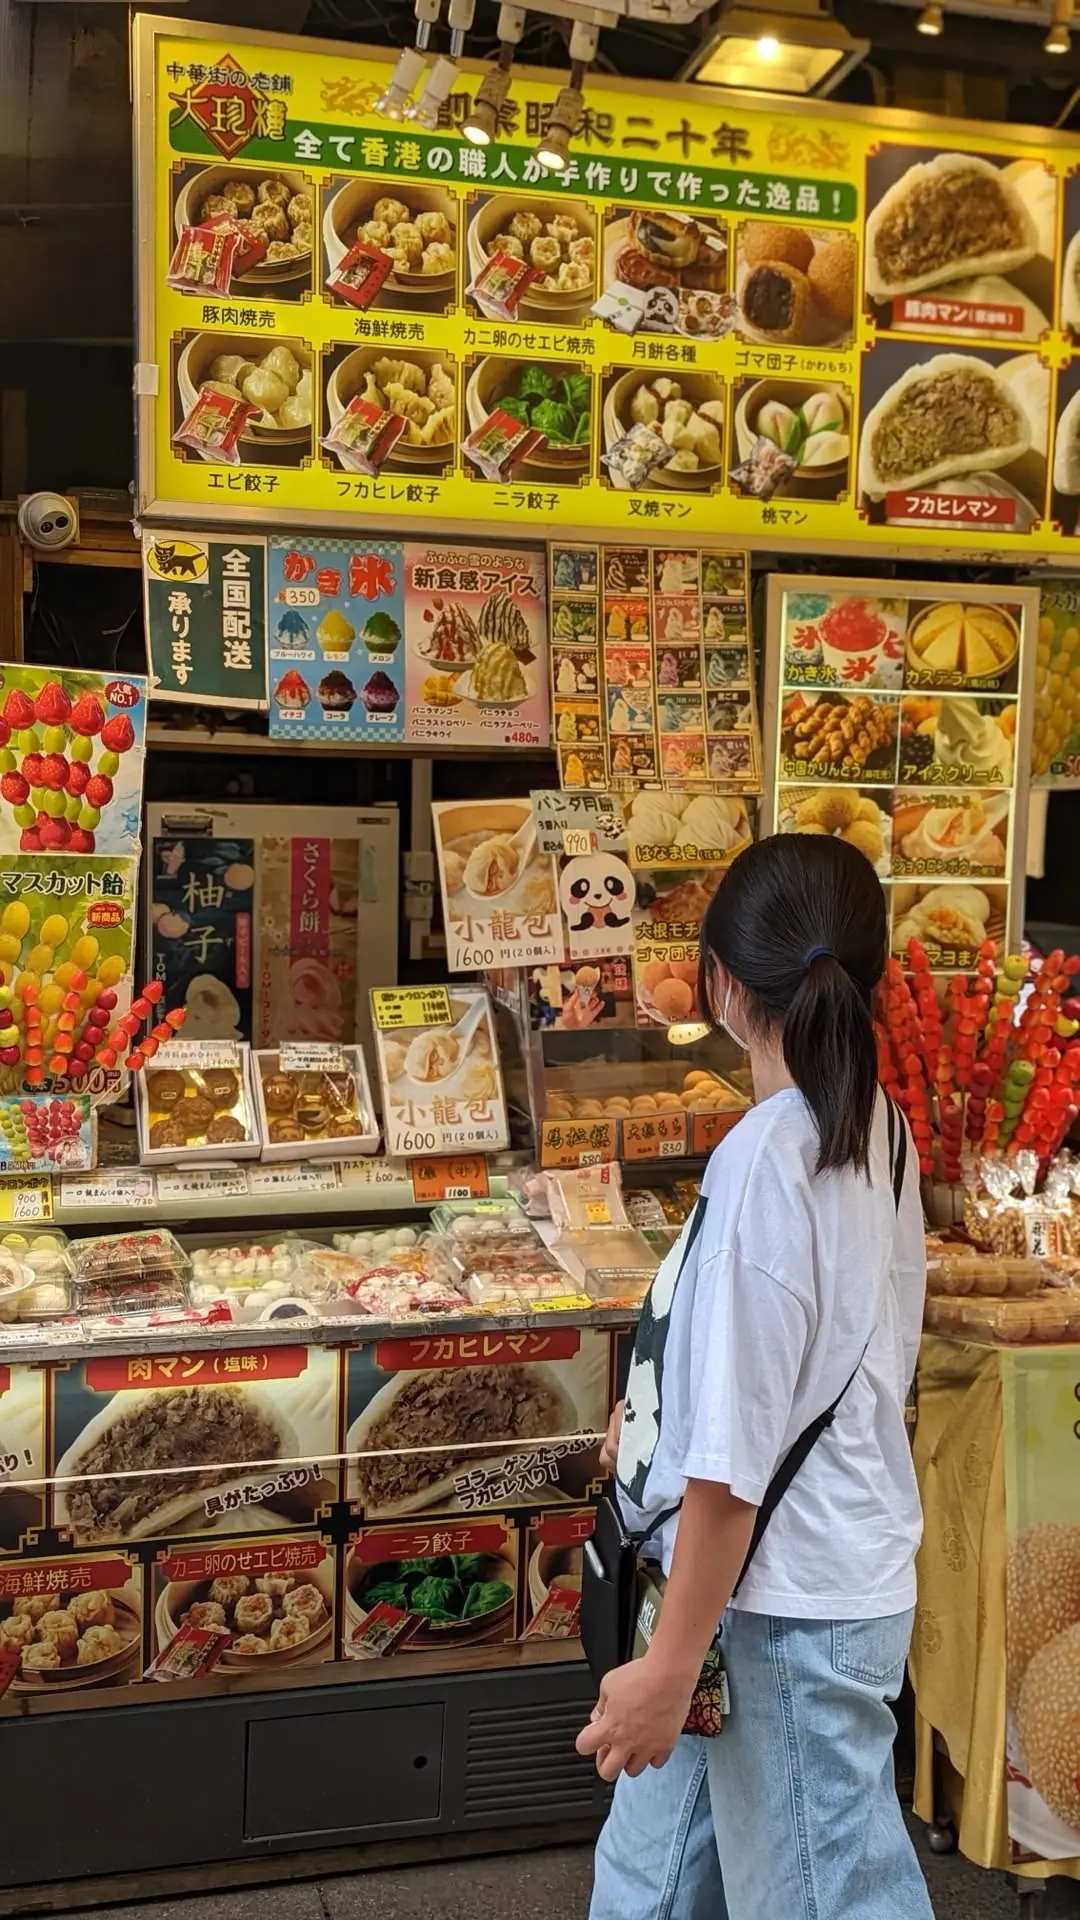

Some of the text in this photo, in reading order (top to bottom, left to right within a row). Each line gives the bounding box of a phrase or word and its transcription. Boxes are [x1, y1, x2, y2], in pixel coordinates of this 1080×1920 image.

[293, 127, 843, 214] 全て香港の職人が手作りで作った逸品！
[202, 305, 276, 329] 豚肉焼売
[354, 317, 425, 342] 海鮮焼売
[463, 328, 595, 355] カニ卵のせエビ焼売
[632, 340, 697, 364] 月餅各種
[207, 473, 281, 493] エビ餃子
[336, 480, 441, 503] フカヒレ餃子
[493, 490, 560, 511] ニラ餃子
[628, 499, 692, 519] 叉焼マン
[904, 496, 998, 519] フカヒレマン
[761, 506, 809, 526] 桃マン
[282, 550, 398, 602] かき氷
[413, 567, 539, 596] 新食感アイス
[289, 590, 317, 604] 350
[221, 548, 253, 670] 全国配送
[167, 590, 194, 685] 承ります
[793, 625, 821, 651] 氷
[370, 654, 393, 663] メロン
[840, 654, 878, 682] 氷
[786, 665, 837, 681] かき氷
[109, 692, 133, 706] NO.1
[112, 682, 133, 695] 人気
[280, 710, 304, 719] イチゴ
[325, 712, 348, 721] コーラ
[367, 713, 395, 722] グレープ
[902, 762, 1004, 783] アイスクリーム
[2, 871, 124, 896] マスカット飴
[300, 841, 322, 934] さくら餅
[91, 911, 121, 923] 新商品
[181, 871, 225, 965] 柚子
[453, 908, 553, 943] 小龍包
[635, 921, 700, 941] 大根モチ
[455, 949, 495, 968] 1600
[636, 945, 701, 963] ゴマ団子
[895, 950, 983, 968] エマヨま
[395, 1095, 495, 1128] 小龍包
[395, 1131, 436, 1151] 1600
[662, 1141, 683, 1154] 830
[580, 1153, 602, 1166] 580
[375, 1171, 394, 1183] 600
[447, 1188, 469, 1197] 1100
[409, 1333, 551, 1362] フカヒレマン
[127, 1354, 270, 1382] 肉マン（塩味）
[453, 1428, 600, 1494] コラーゲンたっぷり
[205, 1463, 323, 1518] 具がたっぷり！
[459, 1462, 561, 1511] フカヒレ入り！
[390, 1531, 474, 1555] ニラ餃子
[172, 1545, 318, 1578] カニ卵のせエビ焼売
[0, 1566, 93, 1596] 海鮮焼売
